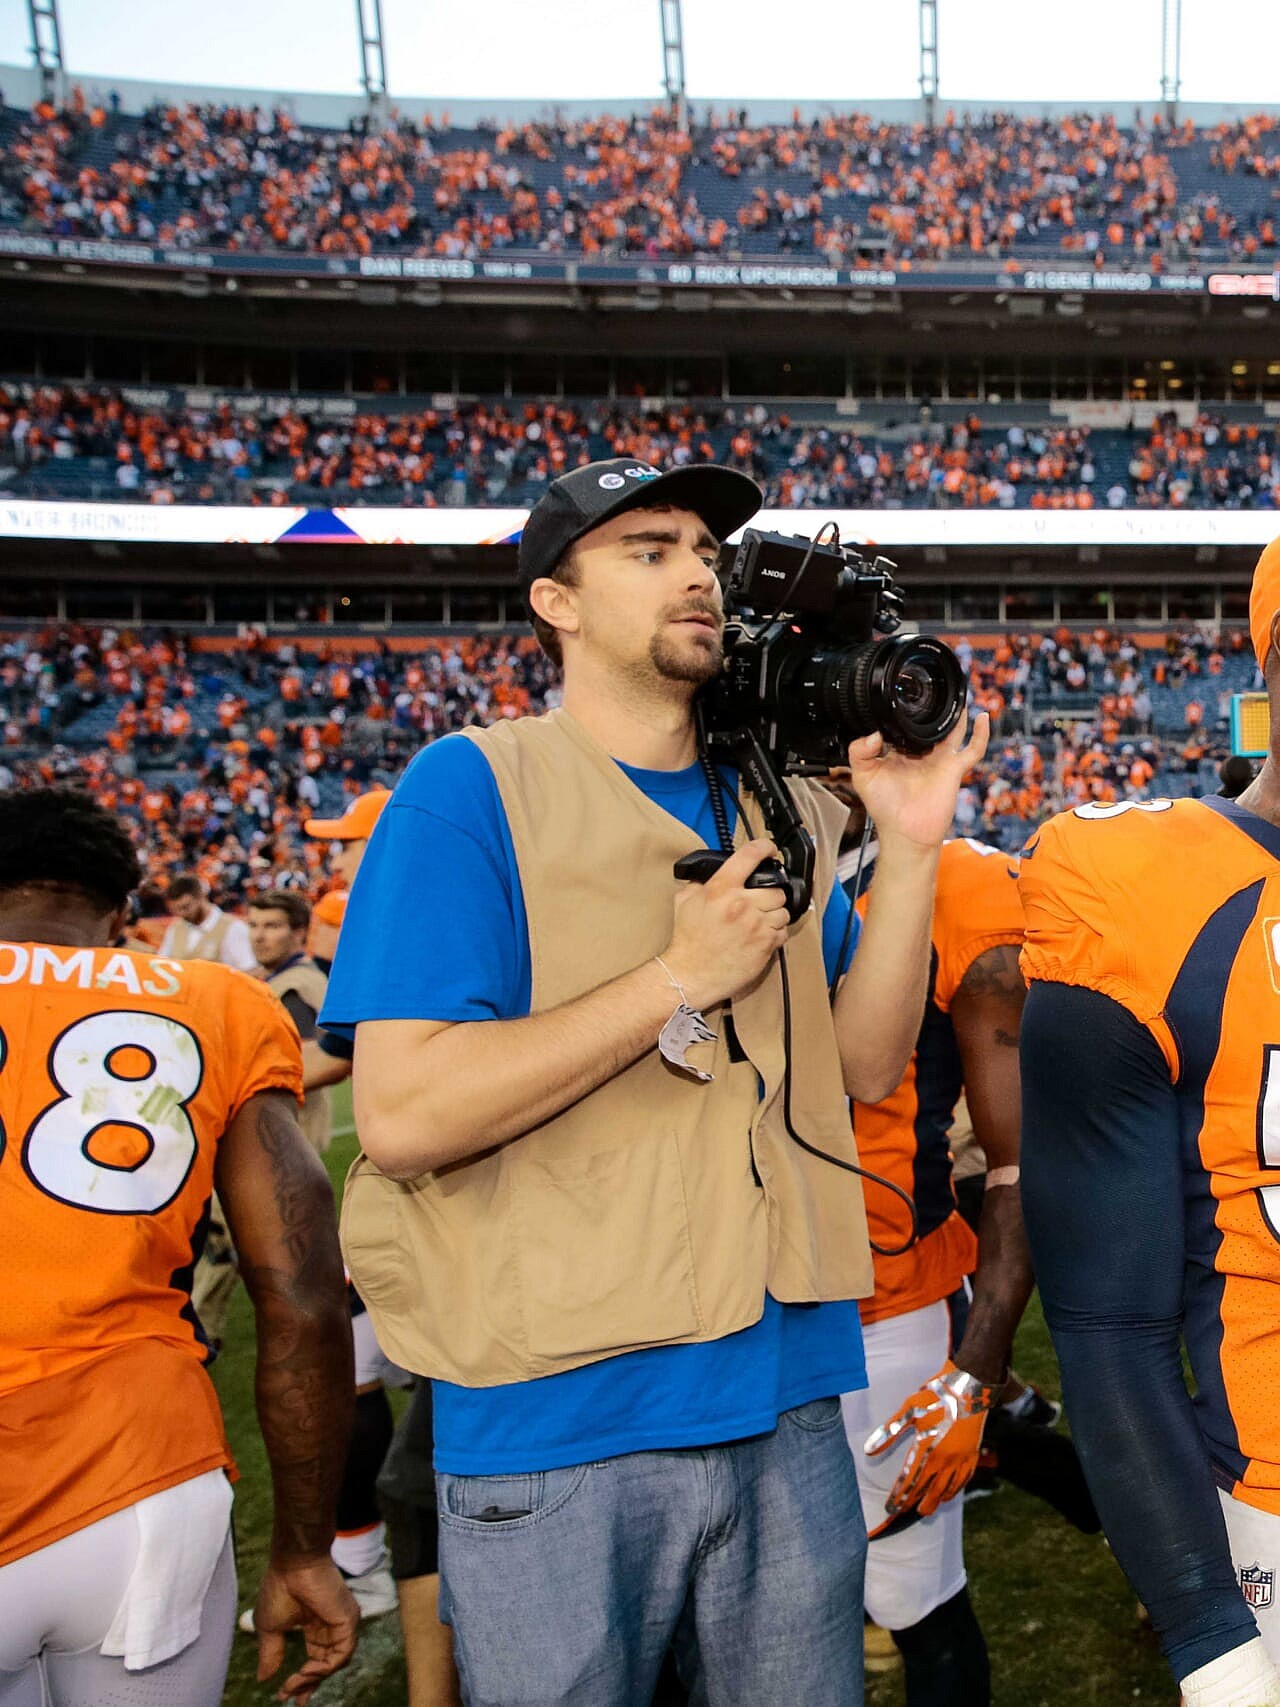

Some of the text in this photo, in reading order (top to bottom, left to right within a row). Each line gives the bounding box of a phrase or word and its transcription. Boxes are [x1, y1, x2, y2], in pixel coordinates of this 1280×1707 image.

[402, 258, 475, 278] REEVES
[1045, 272, 1093, 290] GENE
[761, 568, 786, 580] SONY
[749, 759, 768, 792] SONY
[0, 1009, 204, 1216] 8
[1243, 1583, 1269, 1604] NFL
